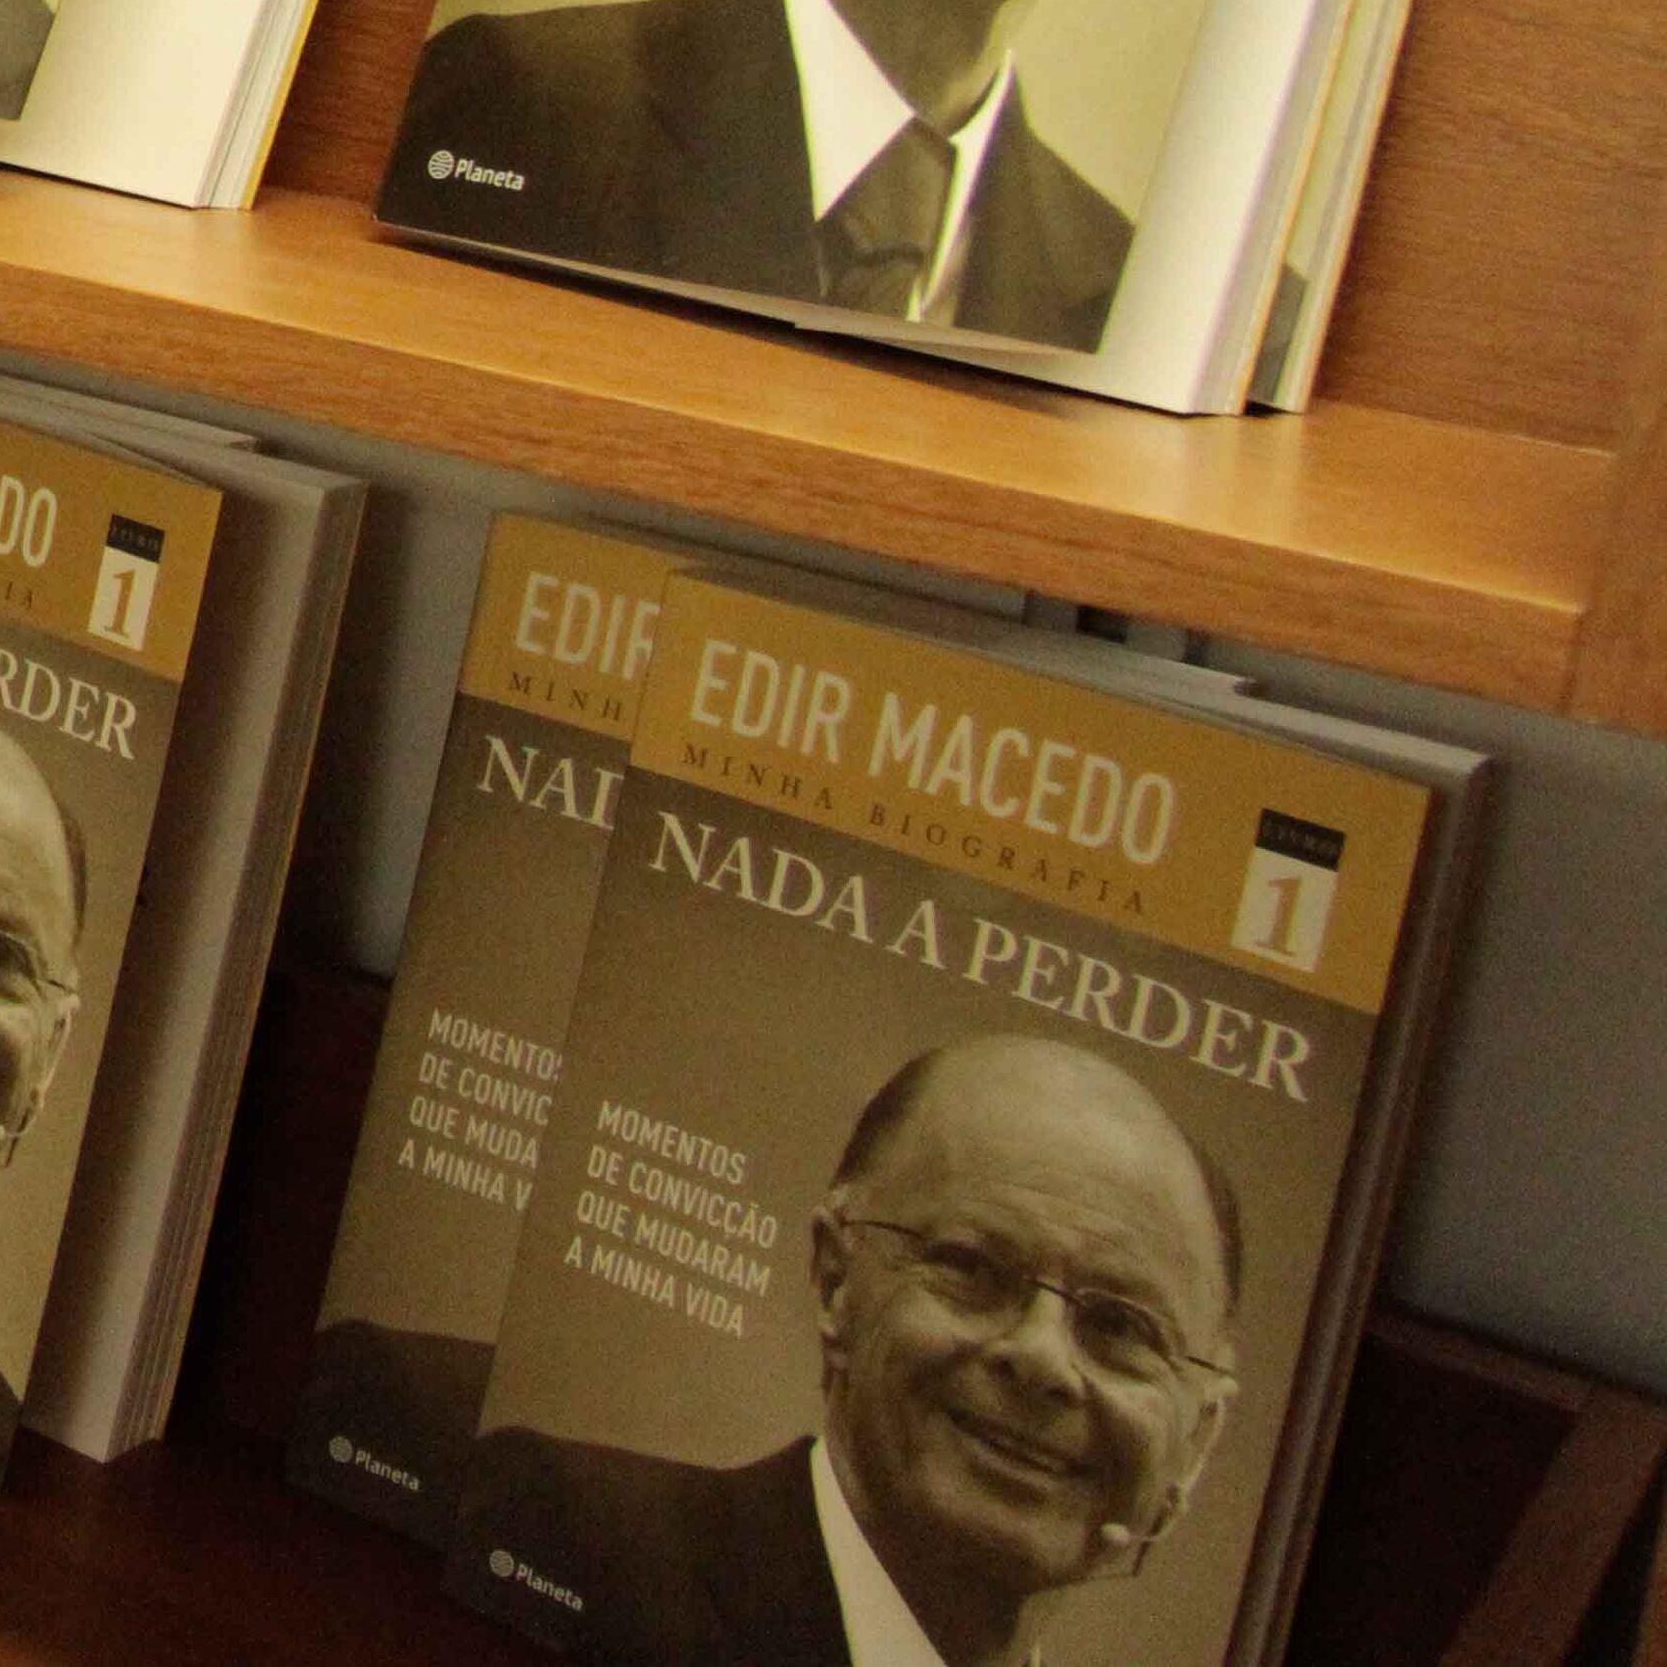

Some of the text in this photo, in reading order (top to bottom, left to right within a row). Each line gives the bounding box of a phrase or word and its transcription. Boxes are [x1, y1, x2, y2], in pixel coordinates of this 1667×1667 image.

[454, 157, 525, 191] Planeta
[104, 568, 137, 639] 1
[688, 639, 1178, 867] EDIR MACEDO
[681, 743, 1149, 916] MINHA BIOGRAFIA
[1255, 874, 1303, 958] 1
[648, 809, 1315, 1104] NADA A PERDER
[419, 1051, 453, 1091] DE
[409, 1095, 460, 1140] QUE
[597, 1099, 747, 1186] MOMENTOS
[398, 1138, 505, 1206] A MINHA
[586, 1144, 621, 1186] DE
[576, 1190, 772, 1298] QUE MUDARAM
[564, 1235, 745, 1338] A MINHA VIDA
[355, 1449, 420, 1492] Planeta
[515, 1562, 585, 1613] Planeta
